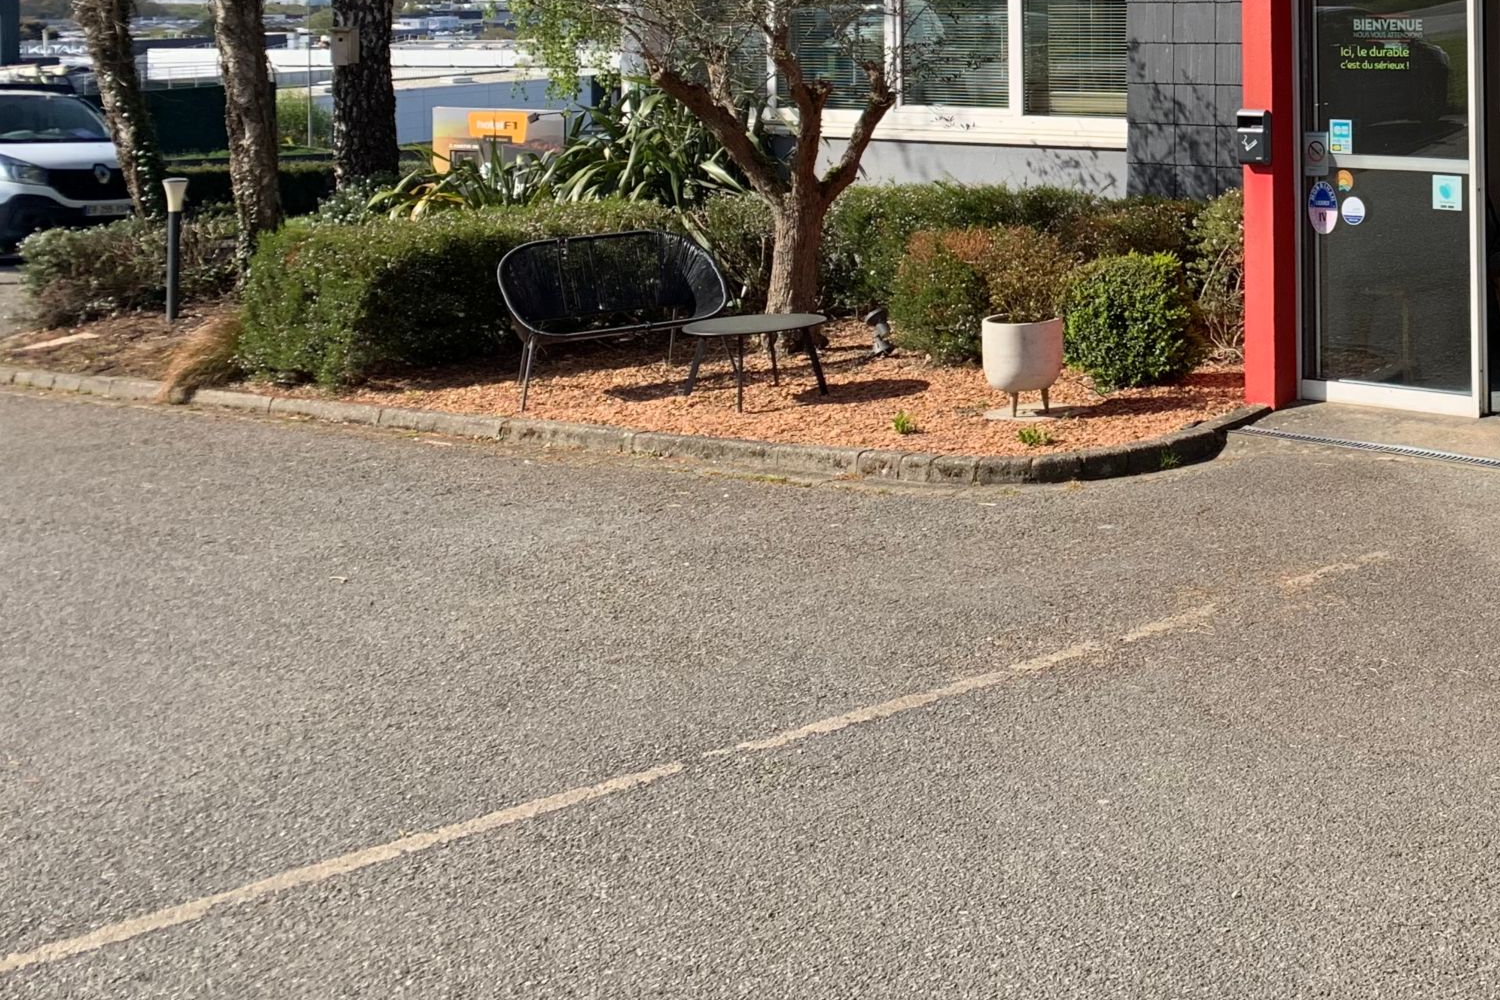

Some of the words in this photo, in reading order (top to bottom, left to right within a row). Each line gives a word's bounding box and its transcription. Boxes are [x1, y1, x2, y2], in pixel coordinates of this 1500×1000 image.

[1353, 18, 1424, 32] BIENVENUE
[1340, 46, 1355, 59] Ici,
[1357, 45, 1368, 57] le
[1369, 45, 1410, 58] durable
[1362, 60, 1373, 70] du
[1374, 60, 1405, 70] sérieux
